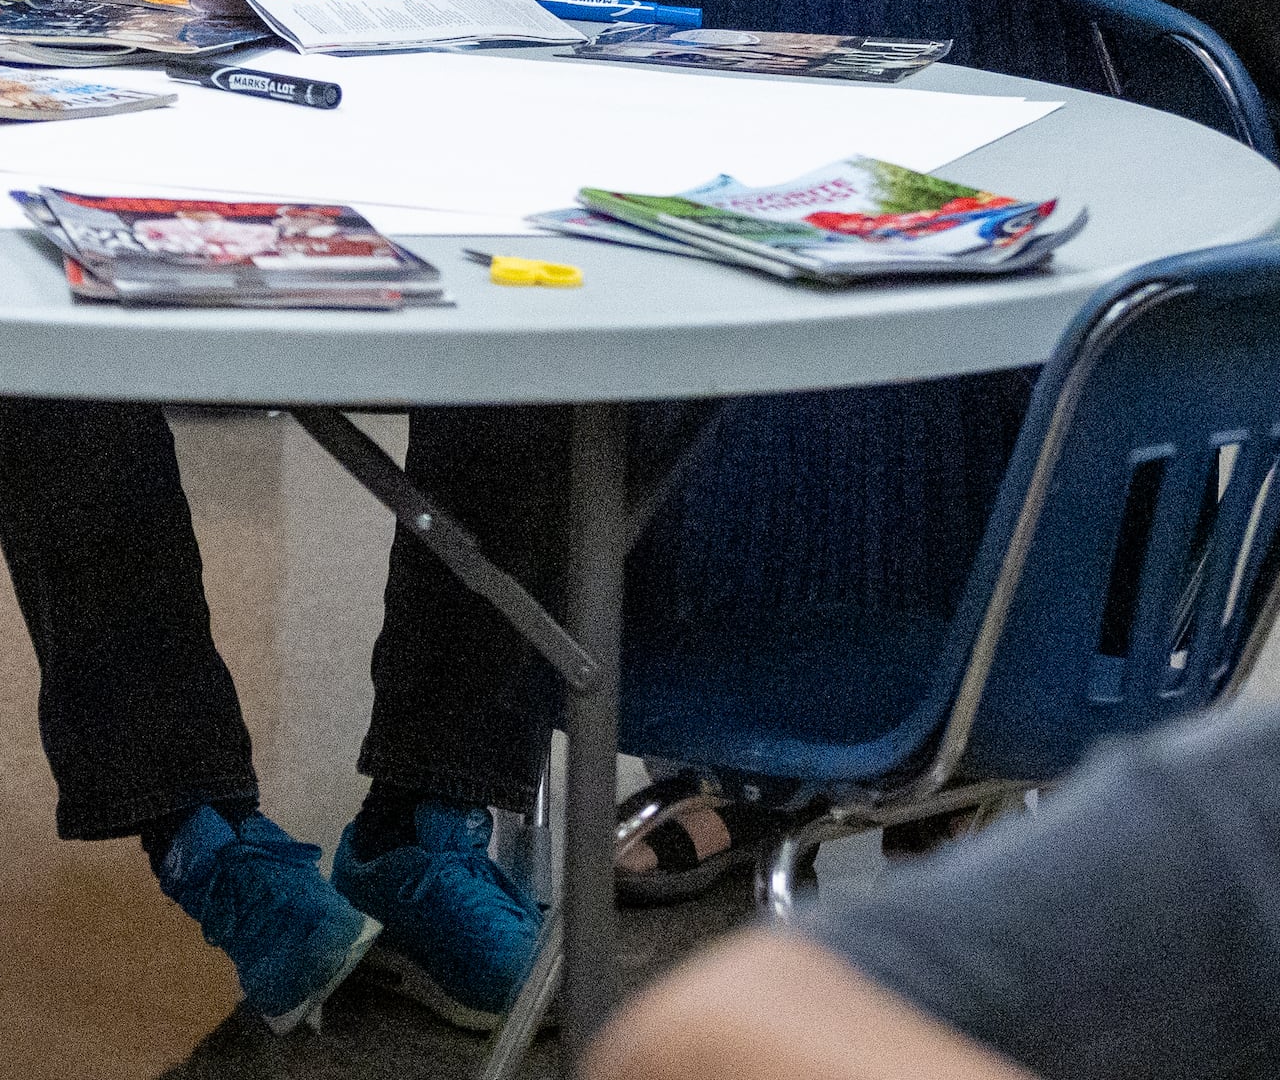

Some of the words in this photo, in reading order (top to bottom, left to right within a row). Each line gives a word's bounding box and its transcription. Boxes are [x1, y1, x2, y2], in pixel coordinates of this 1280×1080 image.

[233, 76, 266, 89] MARKS
[269, 81, 276, 92] A
[277, 83, 296, 95] LOT
